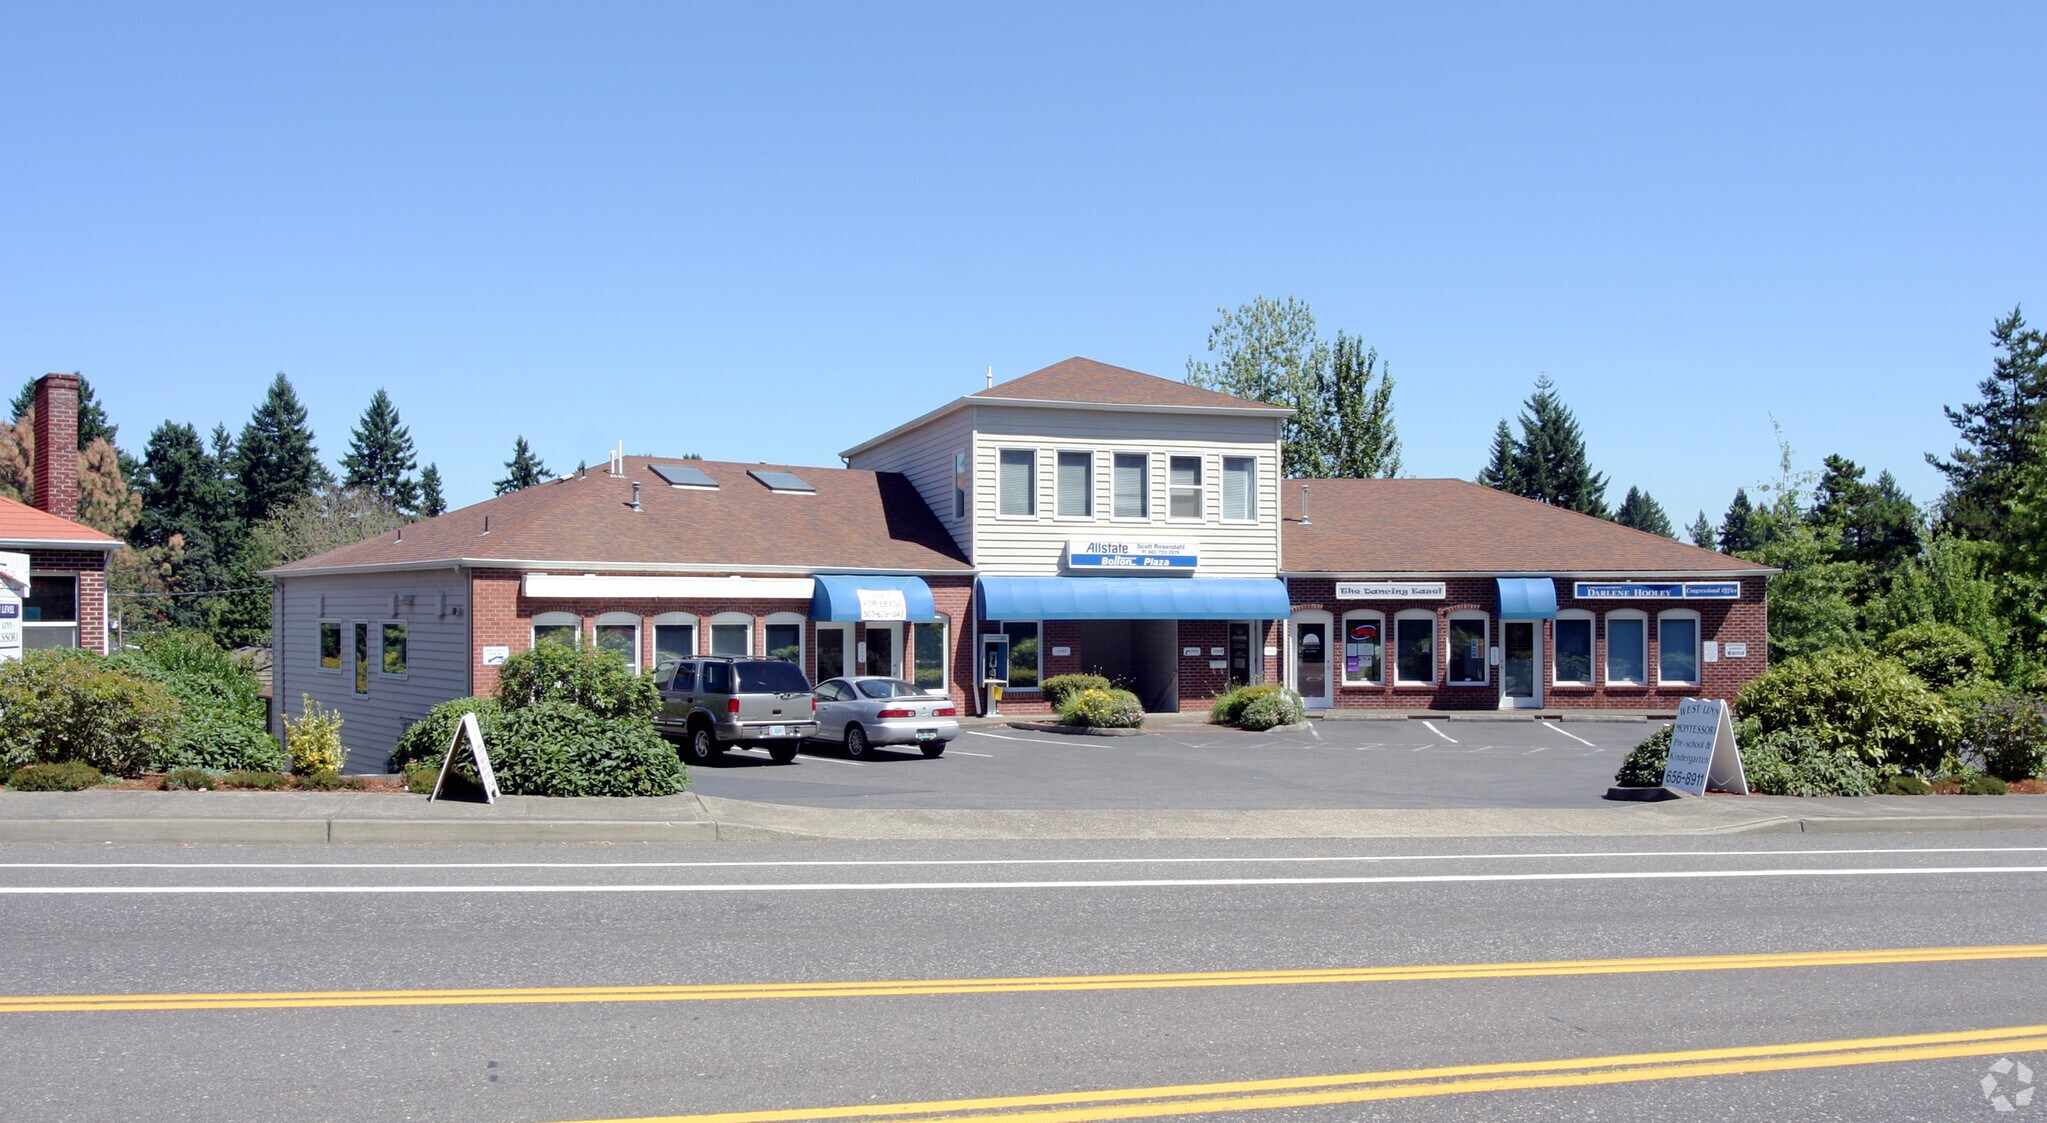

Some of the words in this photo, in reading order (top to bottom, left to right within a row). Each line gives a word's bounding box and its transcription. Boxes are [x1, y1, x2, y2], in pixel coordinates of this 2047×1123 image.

[1085, 542, 1129, 554] Allstate
[1143, 557, 1170, 566] Plaza
[1340, 587, 1360, 595] The
[1364, 587, 1408, 596] Dancing
[1411, 587, 1442, 595] Easel
[1587, 589, 1630, 597] DARLENE
[1634, 589, 1672, 597] HOOLEY
[1, 605, 15, 614] LEVEL
[1680, 704, 1701, 715] WEST
[1702, 705, 1719, 717] LINN
[1676, 723, 1717, 736] MONTESSORI
[1673, 738, 1704, 749] Pre-school
[1669, 752, 1709, 764] Kindergarten
[1665, 770, 1704, 787] 656-8911
